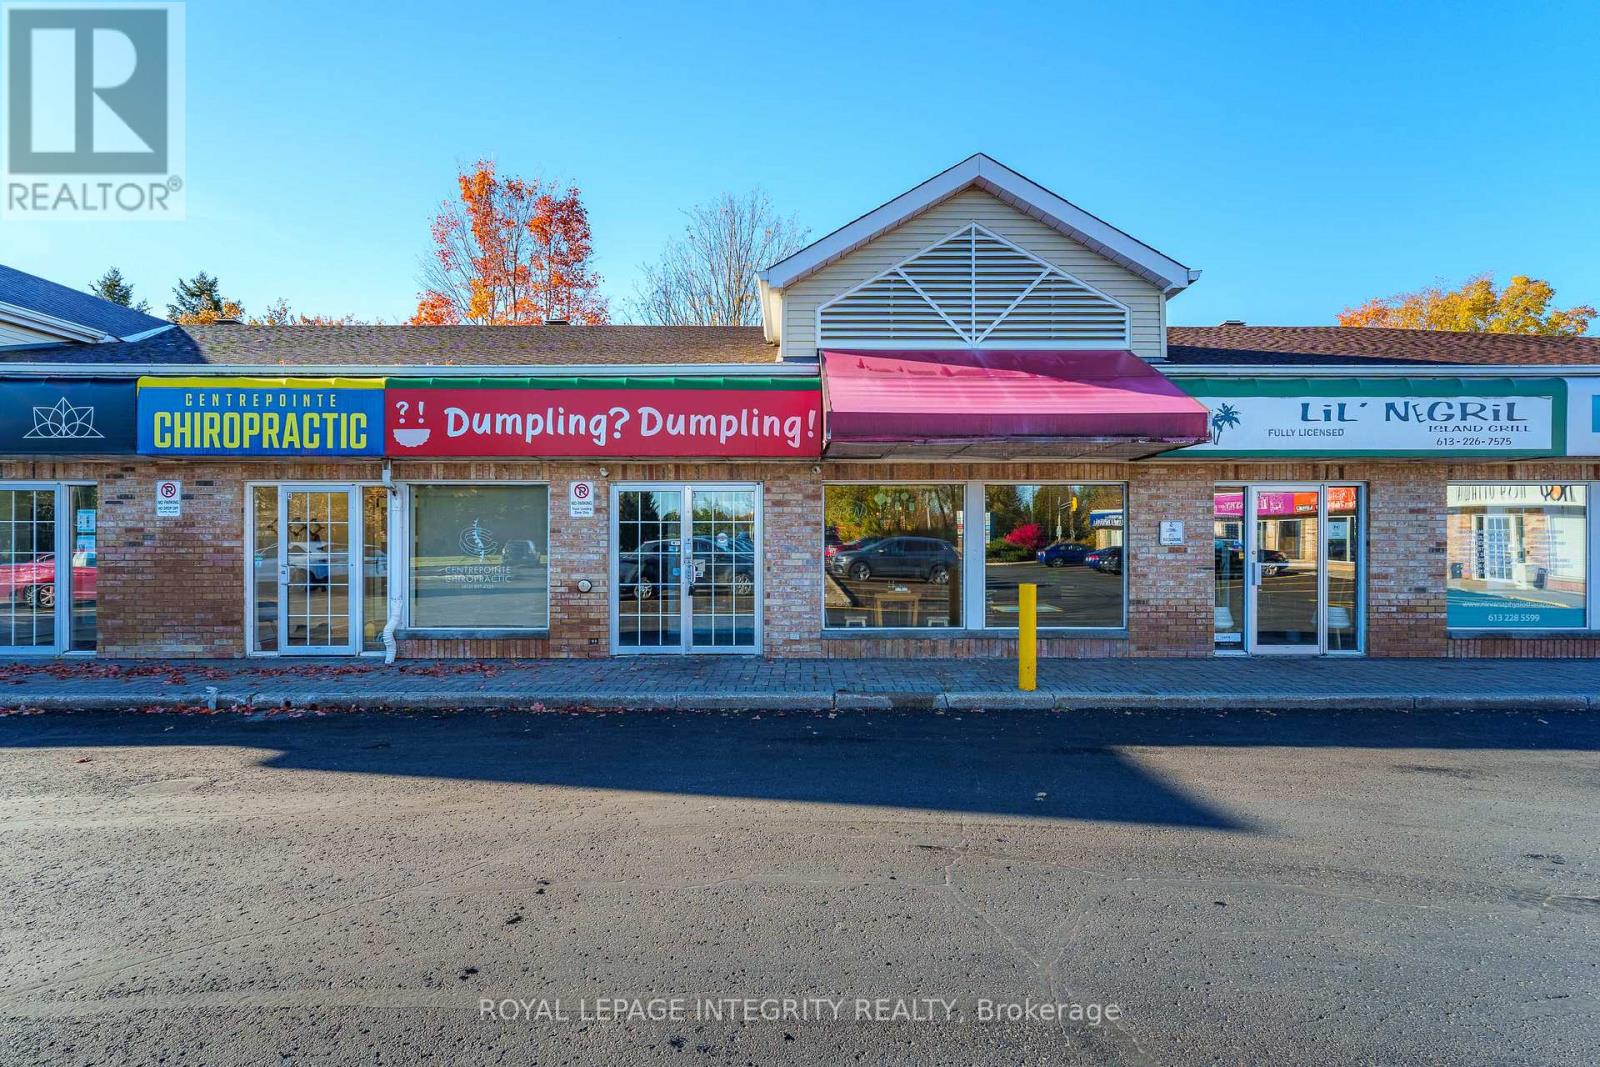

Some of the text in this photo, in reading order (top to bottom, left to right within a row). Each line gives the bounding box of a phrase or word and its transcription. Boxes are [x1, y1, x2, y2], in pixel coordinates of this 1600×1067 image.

[185, 393, 336, 408] CENTREPOINTE
[154, 411, 367, 449] CHIROPRACTIC
[444, 406, 817, 448] Dumpling? Dumpling!
[1268, 428, 1344, 438] FULLY LICENSED
[1488, 425, 1531, 433] GRILL
